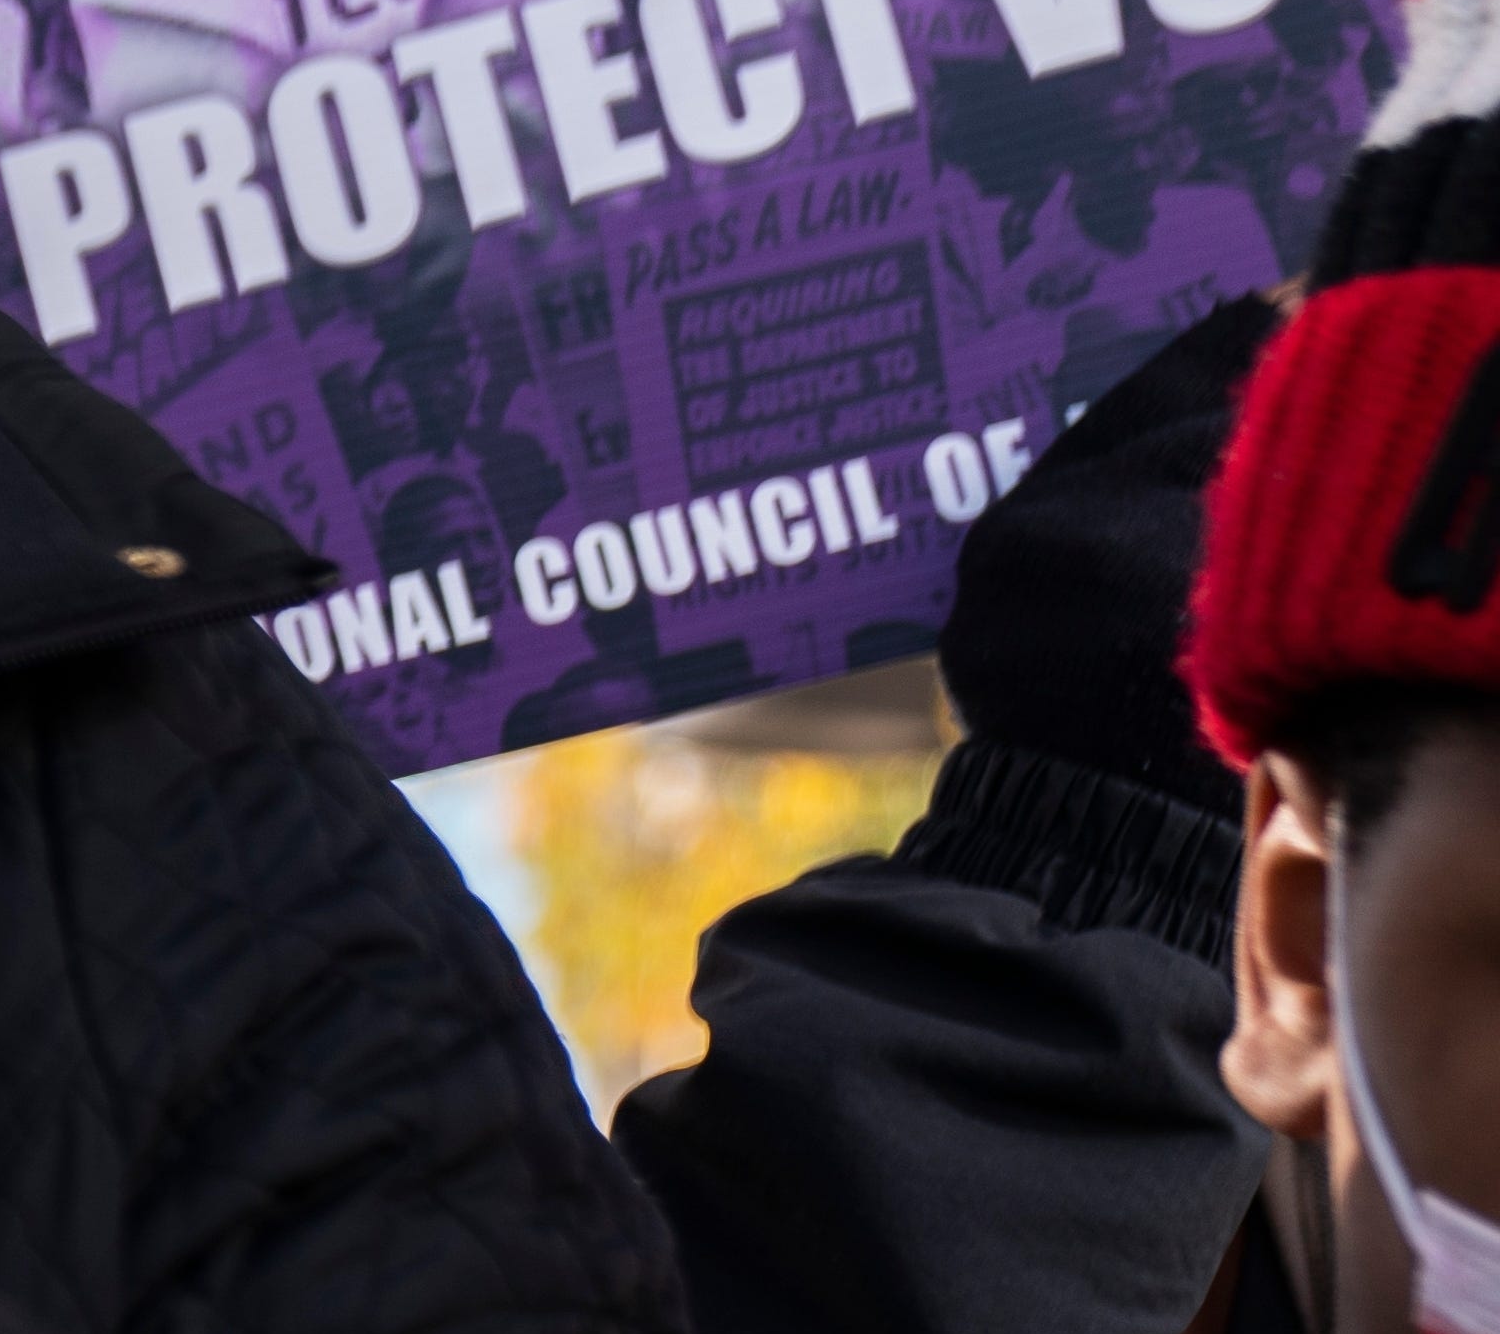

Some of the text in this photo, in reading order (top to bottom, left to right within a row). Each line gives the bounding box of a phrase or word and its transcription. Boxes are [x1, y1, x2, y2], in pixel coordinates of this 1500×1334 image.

[622, 206, 741, 311] PASS
[752, 190, 783, 251] A
[677, 259, 901, 345] REQUIRING
[687, 344, 917, 431] OF JUSTICE TO
[252, 559, 492, 683] ONAL
[512, 456, 899, 628] COUNCIL
[921, 418, 1031, 522] OF
